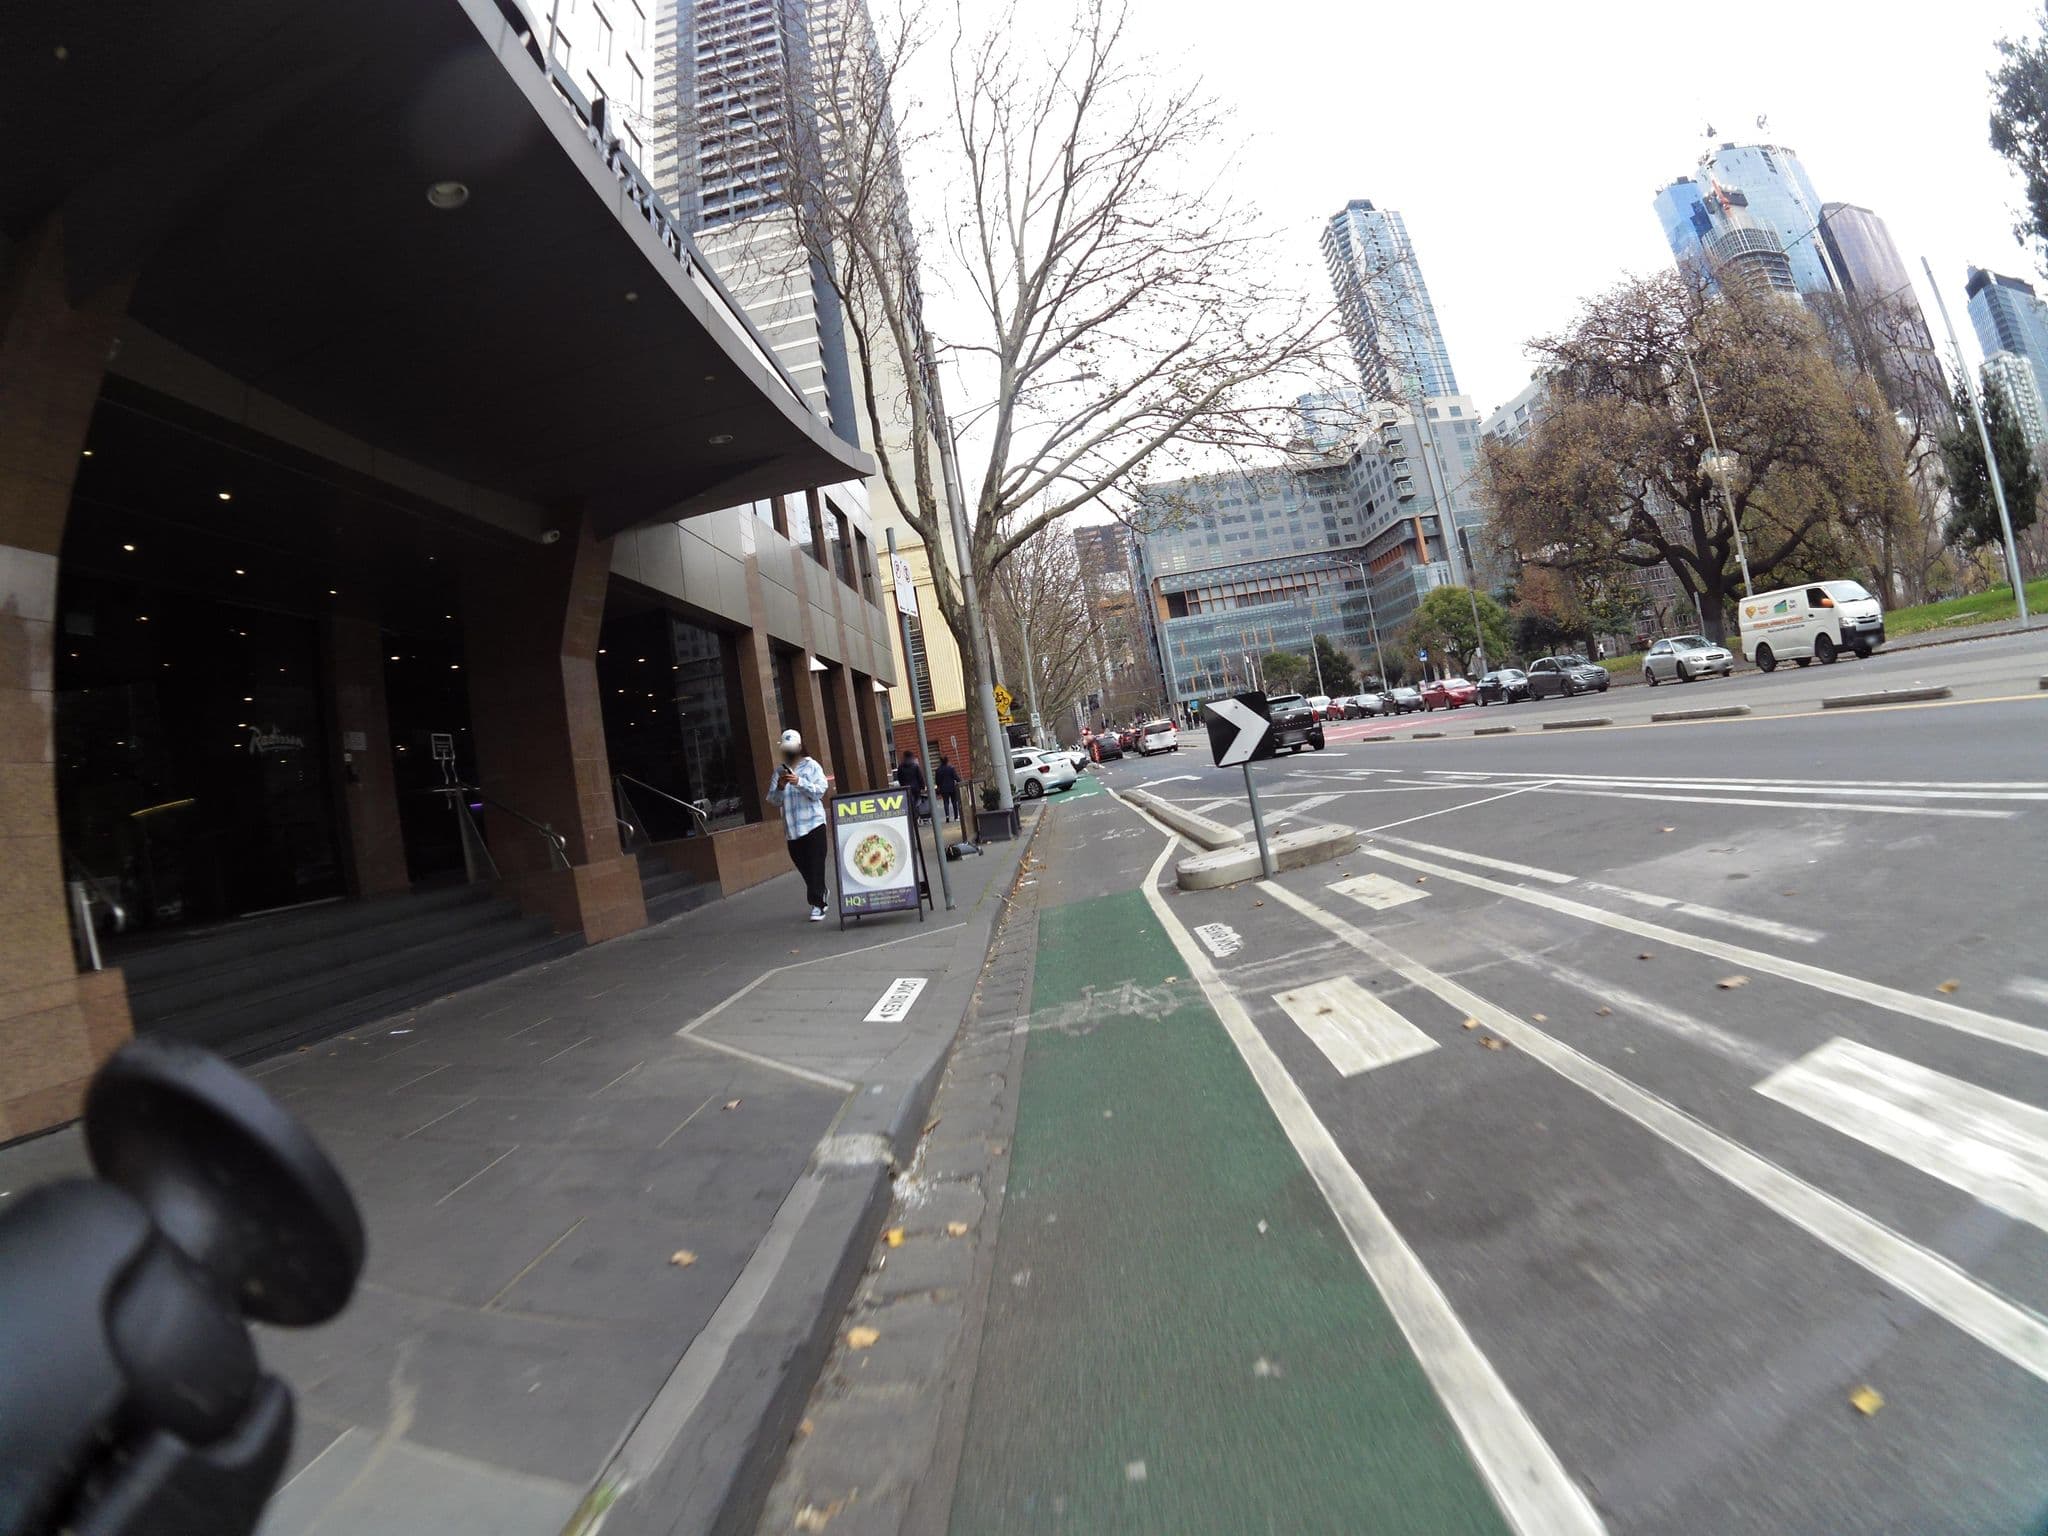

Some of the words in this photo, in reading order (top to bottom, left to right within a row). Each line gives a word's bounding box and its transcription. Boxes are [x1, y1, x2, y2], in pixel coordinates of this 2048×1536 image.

[837, 795, 904, 817] NEW
[893, 980, 921, 995] LOOK
[880, 995, 909, 1013] BIKES
